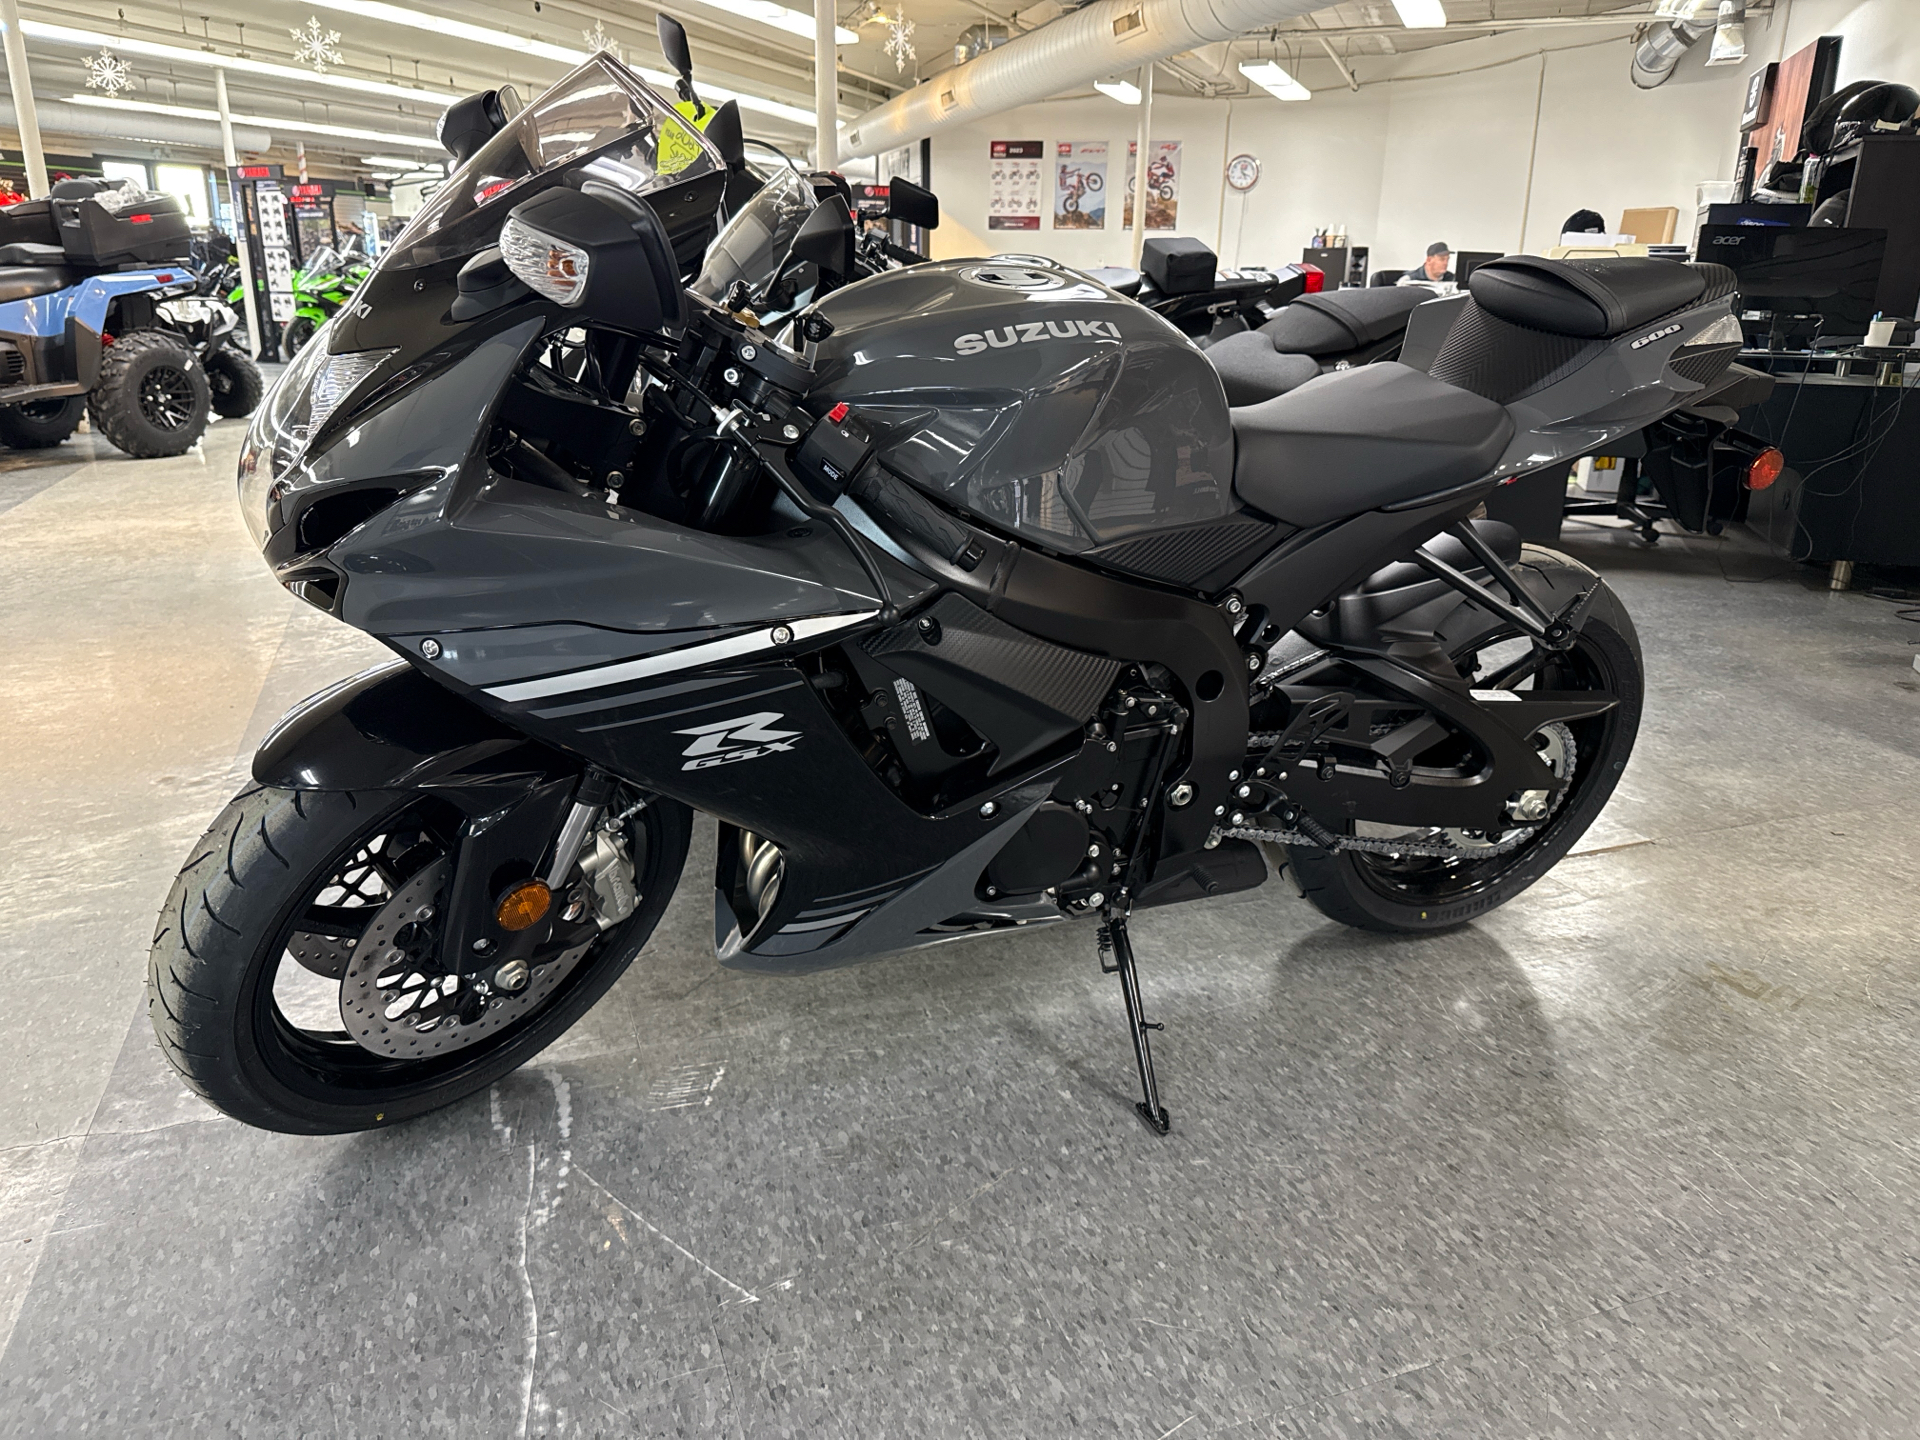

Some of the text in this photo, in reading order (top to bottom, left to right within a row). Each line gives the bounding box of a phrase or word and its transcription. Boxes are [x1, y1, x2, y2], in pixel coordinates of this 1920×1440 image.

[1712, 235, 1745, 245] acer
[953, 320, 1122, 356] SUZUKI
[1630, 324, 1682, 350] 600
[822, 464, 840, 481] MODE
[680, 735, 804, 771] GSX
